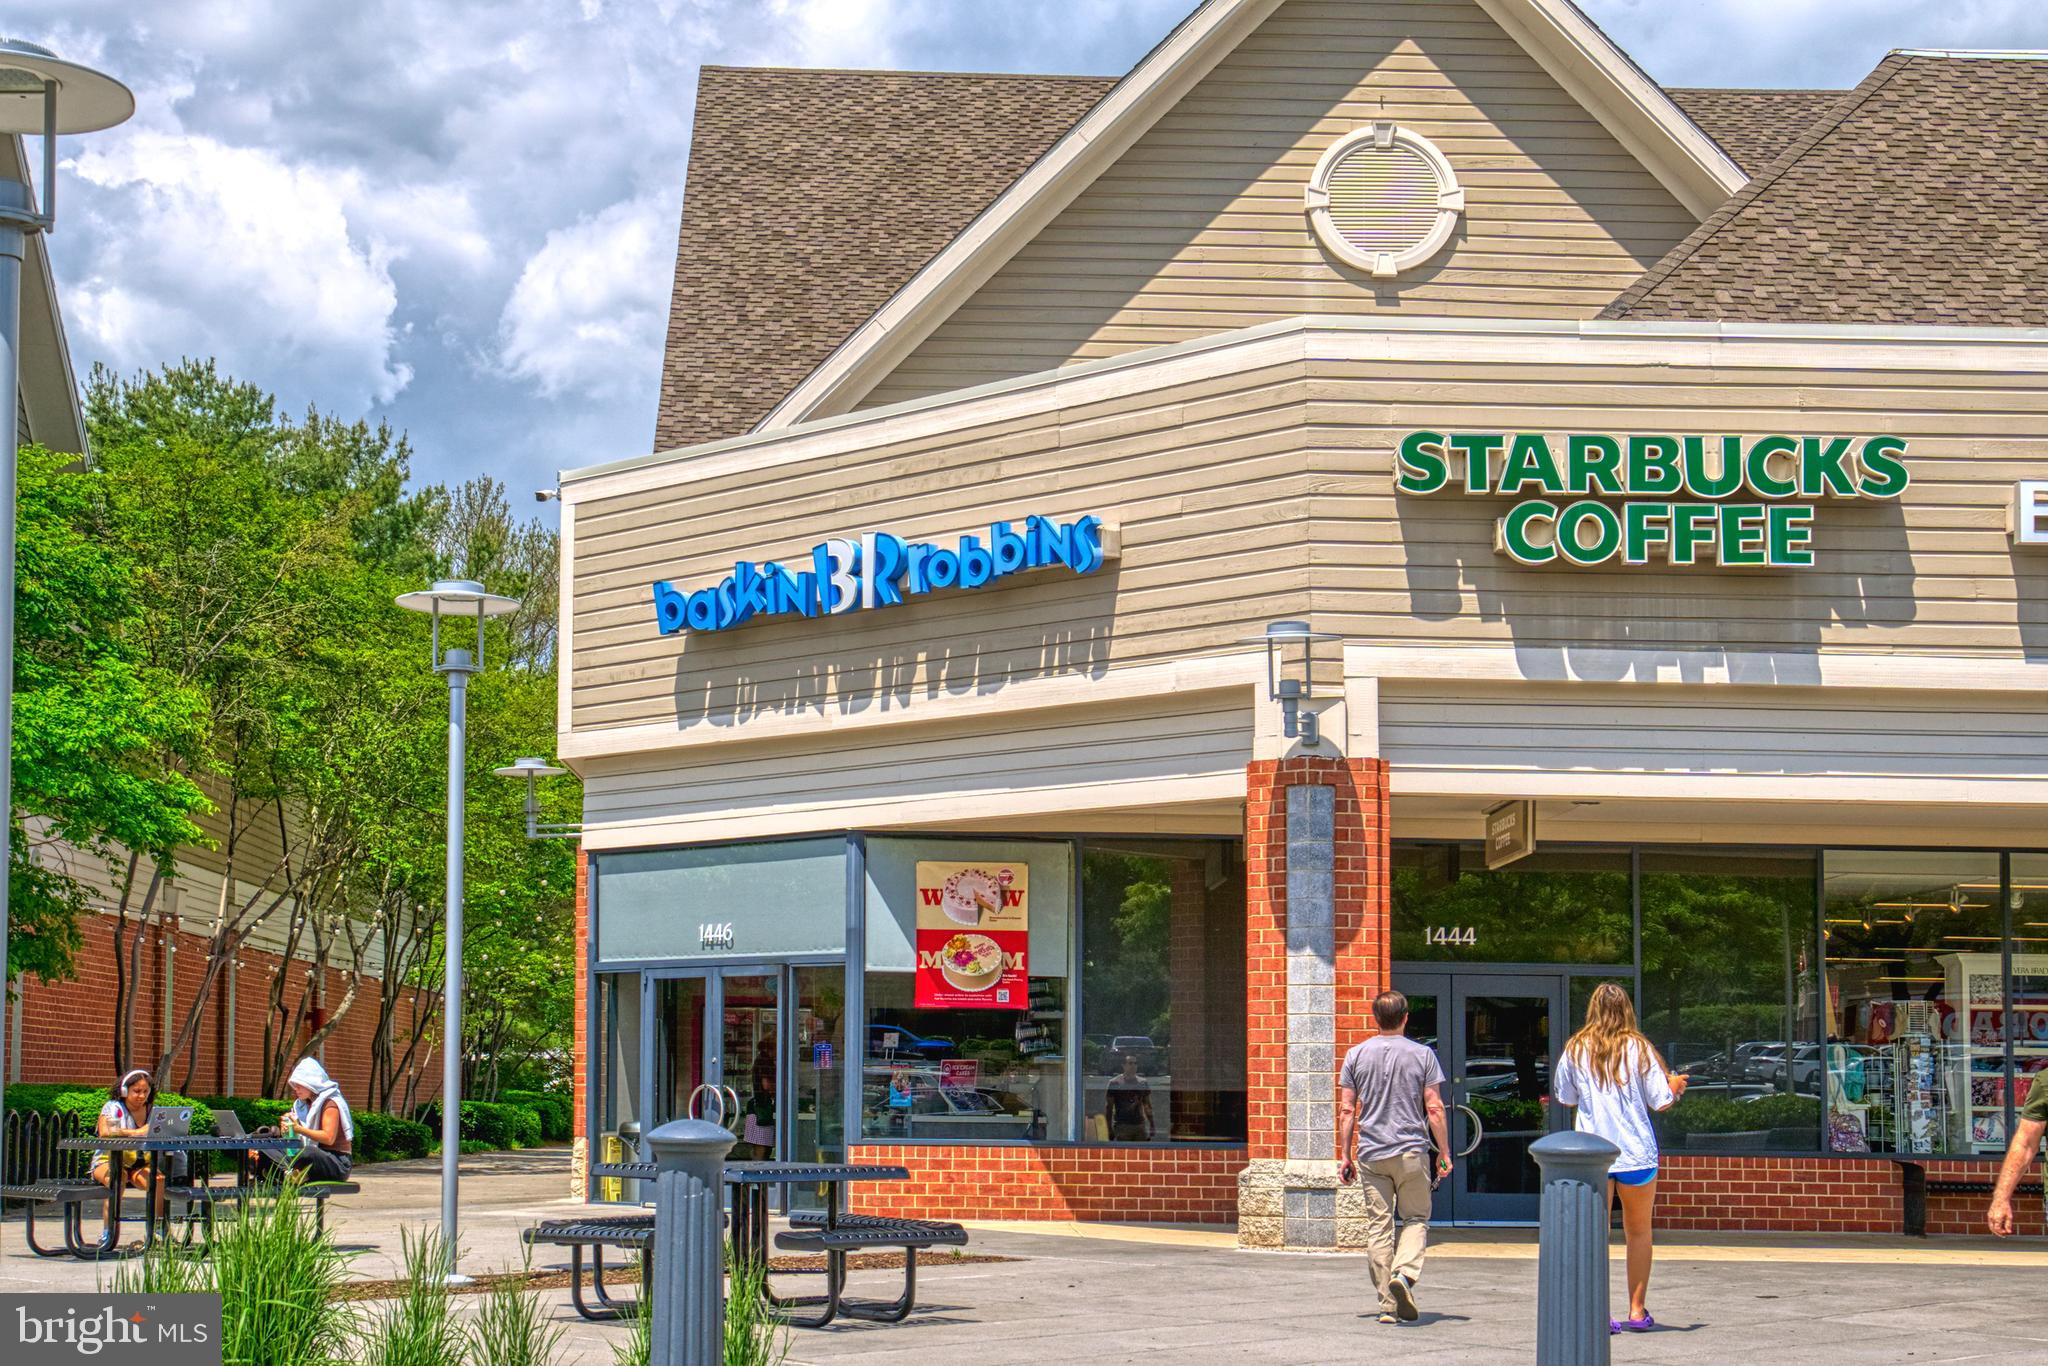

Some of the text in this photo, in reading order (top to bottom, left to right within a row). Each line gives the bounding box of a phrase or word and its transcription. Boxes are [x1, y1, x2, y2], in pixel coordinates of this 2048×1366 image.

[1396, 430, 1911, 499] STARBUCKS
[1499, 500, 1815, 567] COFFEE
[698, 922, 733, 942] 1446
[1424, 926, 1477, 945] 1444
